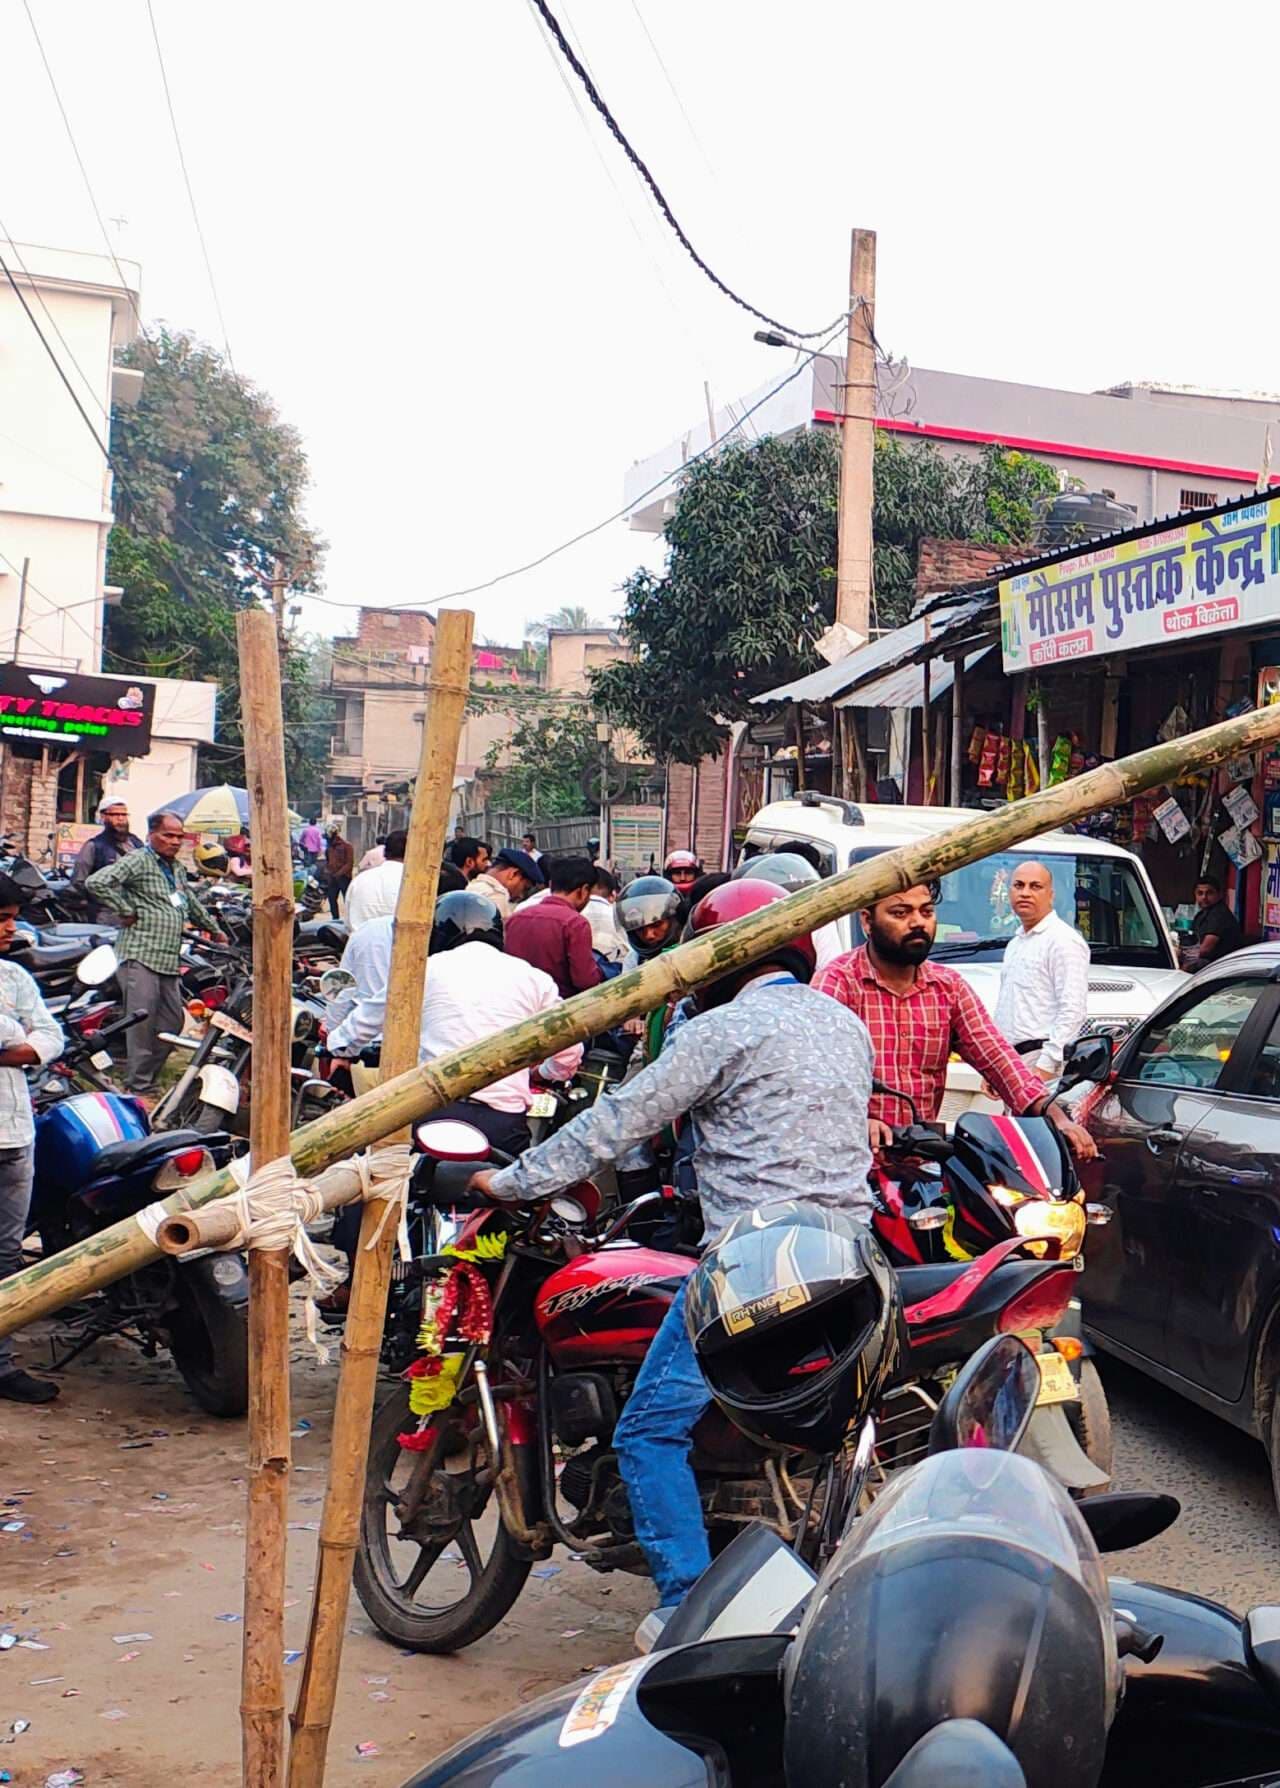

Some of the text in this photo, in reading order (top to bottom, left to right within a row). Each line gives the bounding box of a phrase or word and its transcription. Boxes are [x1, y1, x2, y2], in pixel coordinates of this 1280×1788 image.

[1026, 520, 1267, 640] मौसम पुस्तक केन्द्र
[1166, 602, 1236, 631] थोक विक्रेता
[1031, 635, 1089, 663] कॉपी कलम
